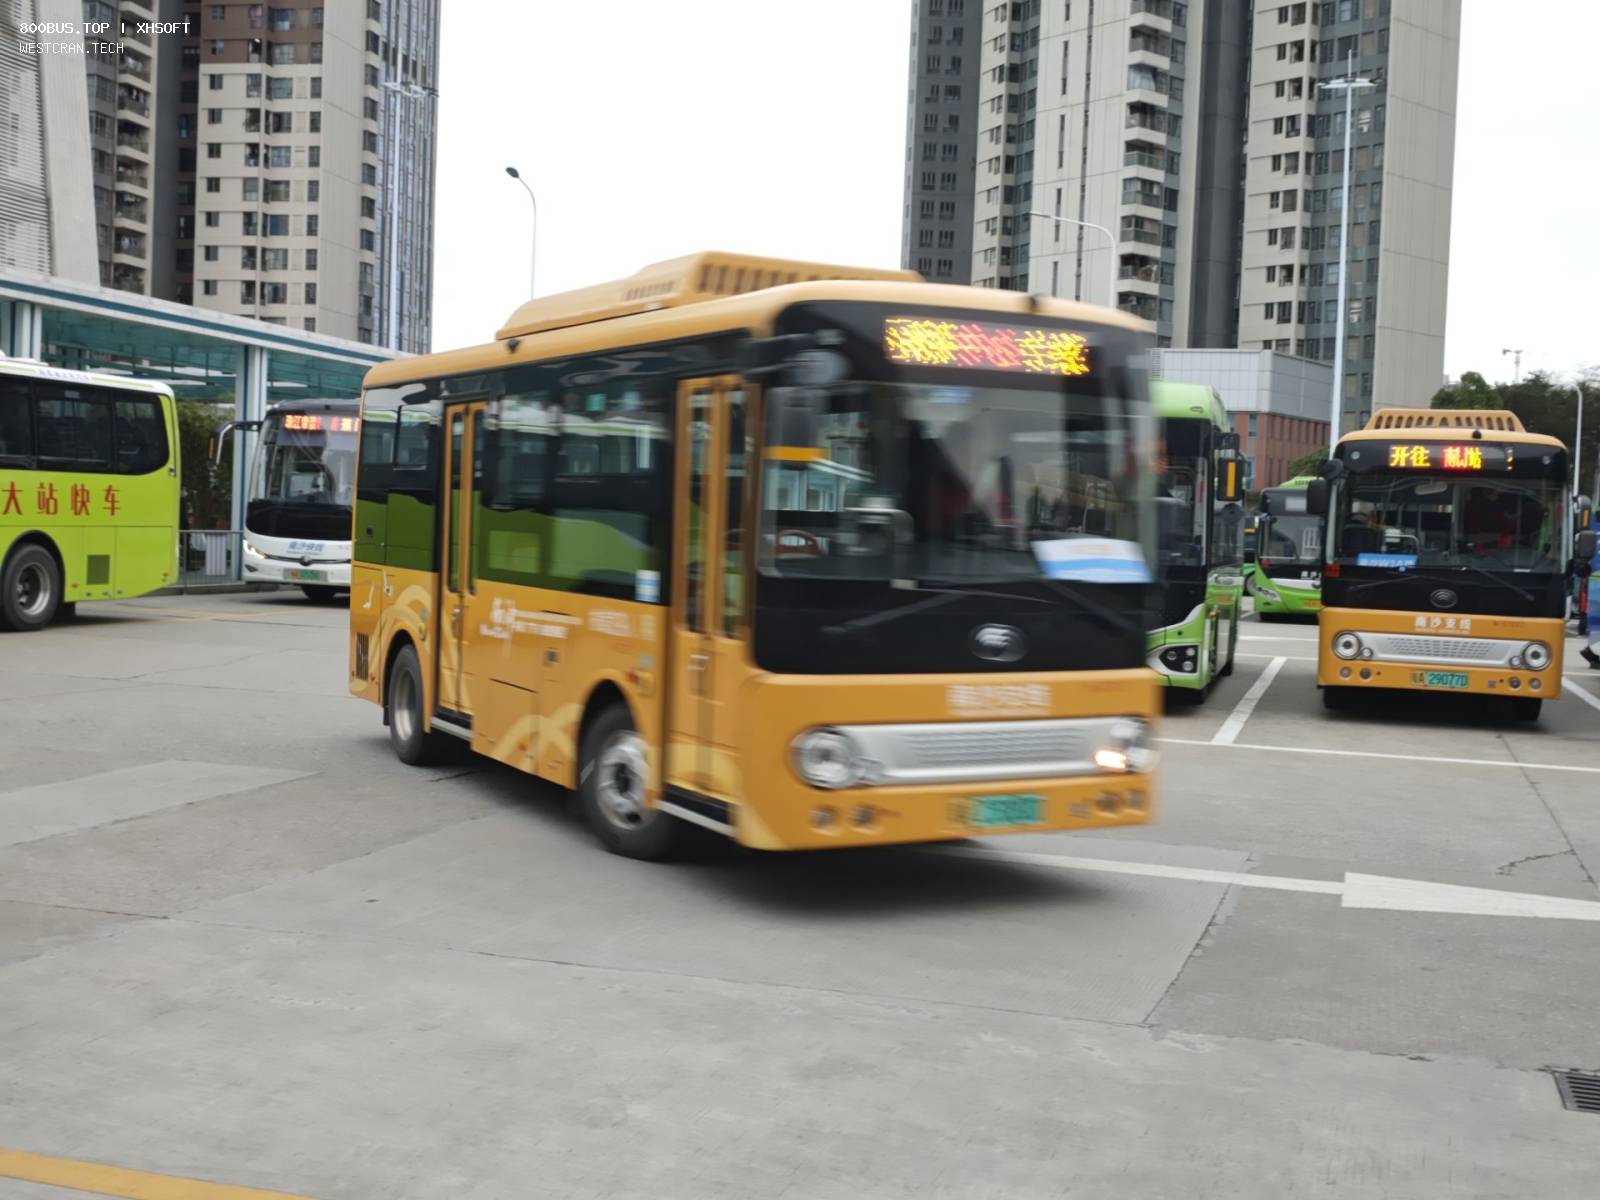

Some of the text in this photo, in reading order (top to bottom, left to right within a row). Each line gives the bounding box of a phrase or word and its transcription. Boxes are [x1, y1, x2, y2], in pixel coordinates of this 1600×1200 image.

[1389, 445, 1431, 468] 开往
[1, 480, 121, 516] 大站快车
